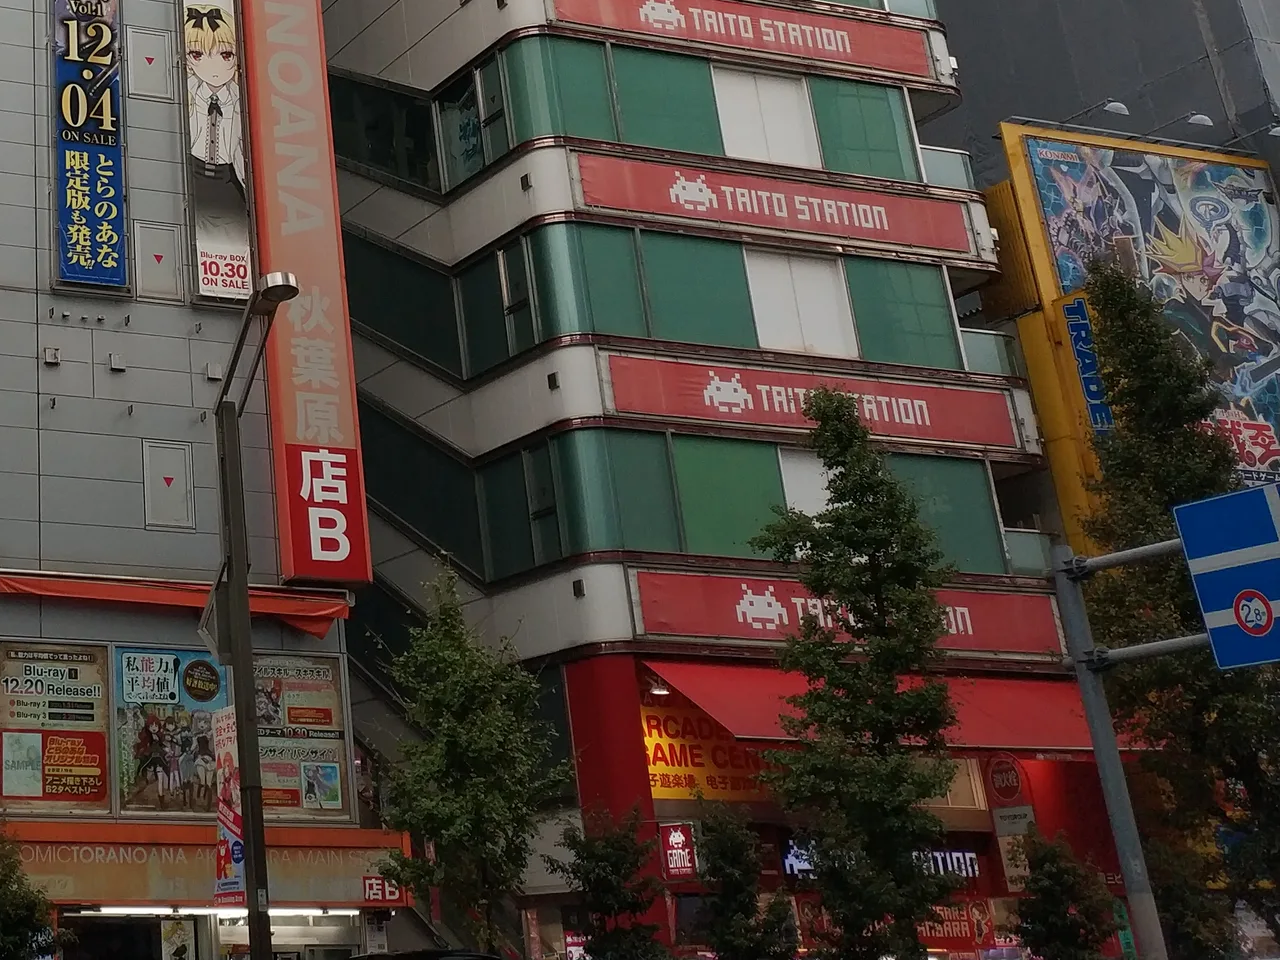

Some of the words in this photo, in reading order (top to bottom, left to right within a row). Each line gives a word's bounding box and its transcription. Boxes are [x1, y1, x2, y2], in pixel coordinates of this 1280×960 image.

[688, 6, 754, 40] TAITO
[760, 20, 852, 54] STATION
[62, 130, 80, 141] ON
[83, 132, 117, 146] SALE
[1038, 149, 1080, 162] KONAMI
[94, 152, 119, 269] とらのあな
[721, 185, 789, 218] TAITO
[795, 196, 889, 231] STATION
[200, 251, 228, 262] Blu-ray
[229, 252, 248, 263] BOX
[200, 261, 248, 280] 10.30
[202, 276, 219, 287] ON
[221, 278, 250, 290] SALE
[1062, 297, 1116, 434] TRADE
[756, 384, 818, 415] TAIT
[832, 392, 931, 426] ATION
[24, 665, 66, 680] Blu-ray
[1, 677, 44, 695] 12.20
[46, 684, 101, 697] Release!!
[126, 676, 170, 693] 平均値
[16, 700, 41, 708] Blu-ray
[16, 712, 41, 720] Blu-ray
[283, 727, 308, 738] 10.30
[643, 714, 730, 742] RCAD
[645, 742, 705, 768] AME
[4, 759, 42, 771] SAMPLE
[18, 843, 188, 865] OMICTORANOANA
[297, 849, 344, 866] MAIN
[666, 848, 693, 868] GAME
